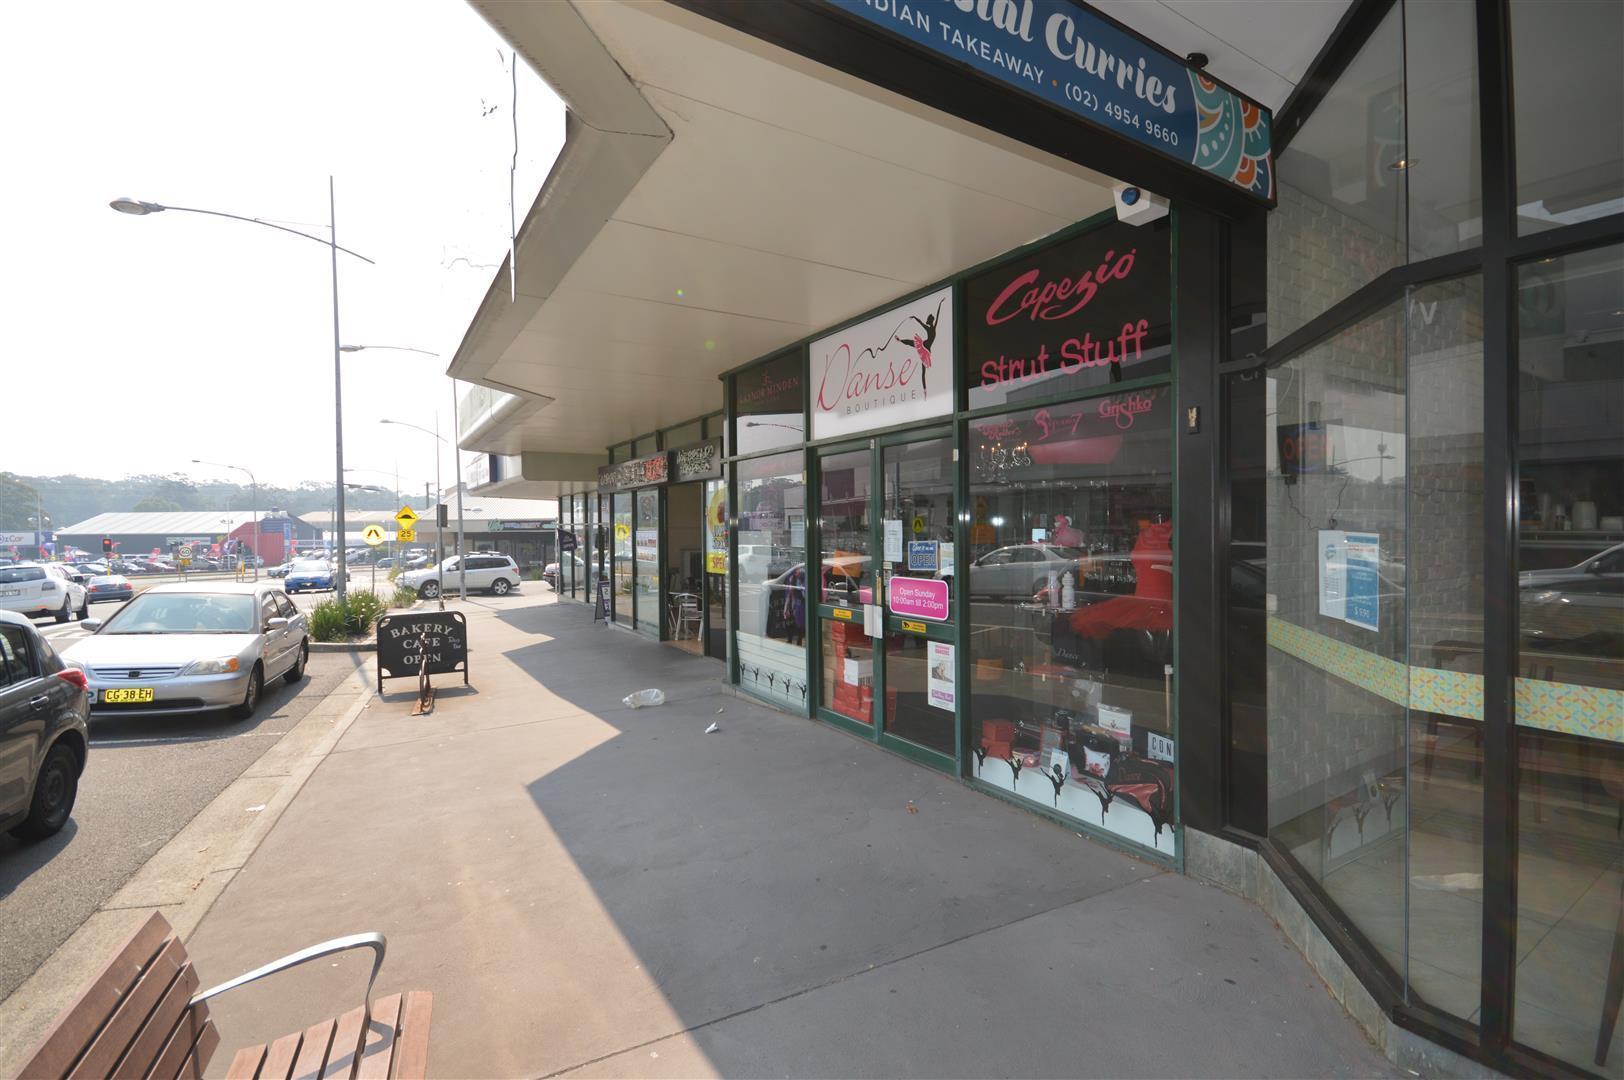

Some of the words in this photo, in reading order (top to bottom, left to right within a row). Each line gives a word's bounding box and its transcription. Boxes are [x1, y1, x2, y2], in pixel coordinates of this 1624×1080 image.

[1045, 12, 1176, 114] Curries
[939, 20, 1044, 84] TAKEAWAY
[1065, 82, 1099, 112] (02)
[1104, 101, 1140, 129] 4954
[1145, 119, 1179, 146] 9660
[986, 248, 1137, 326] Capezio
[981, 344, 1049, 392] Strut
[1060, 319, 1149, 375] Stuff
[816, 343, 918, 411] Danse
[846, 389, 917, 415] BOUTIQUE
[1099, 395, 1152, 429] Grishko
[400, 530, 412, 538] 25
[893, 595, 915, 606] 10:00am
[922, 599, 944, 610] 2:00pm
[900, 587, 914, 597] Open
[914, 588, 936, 600] Sunday
[390, 623, 453, 638] BAKERY
[106, 690, 120, 700] CG
[123, 689, 136, 699] 38
[138, 688, 152, 699] EH
